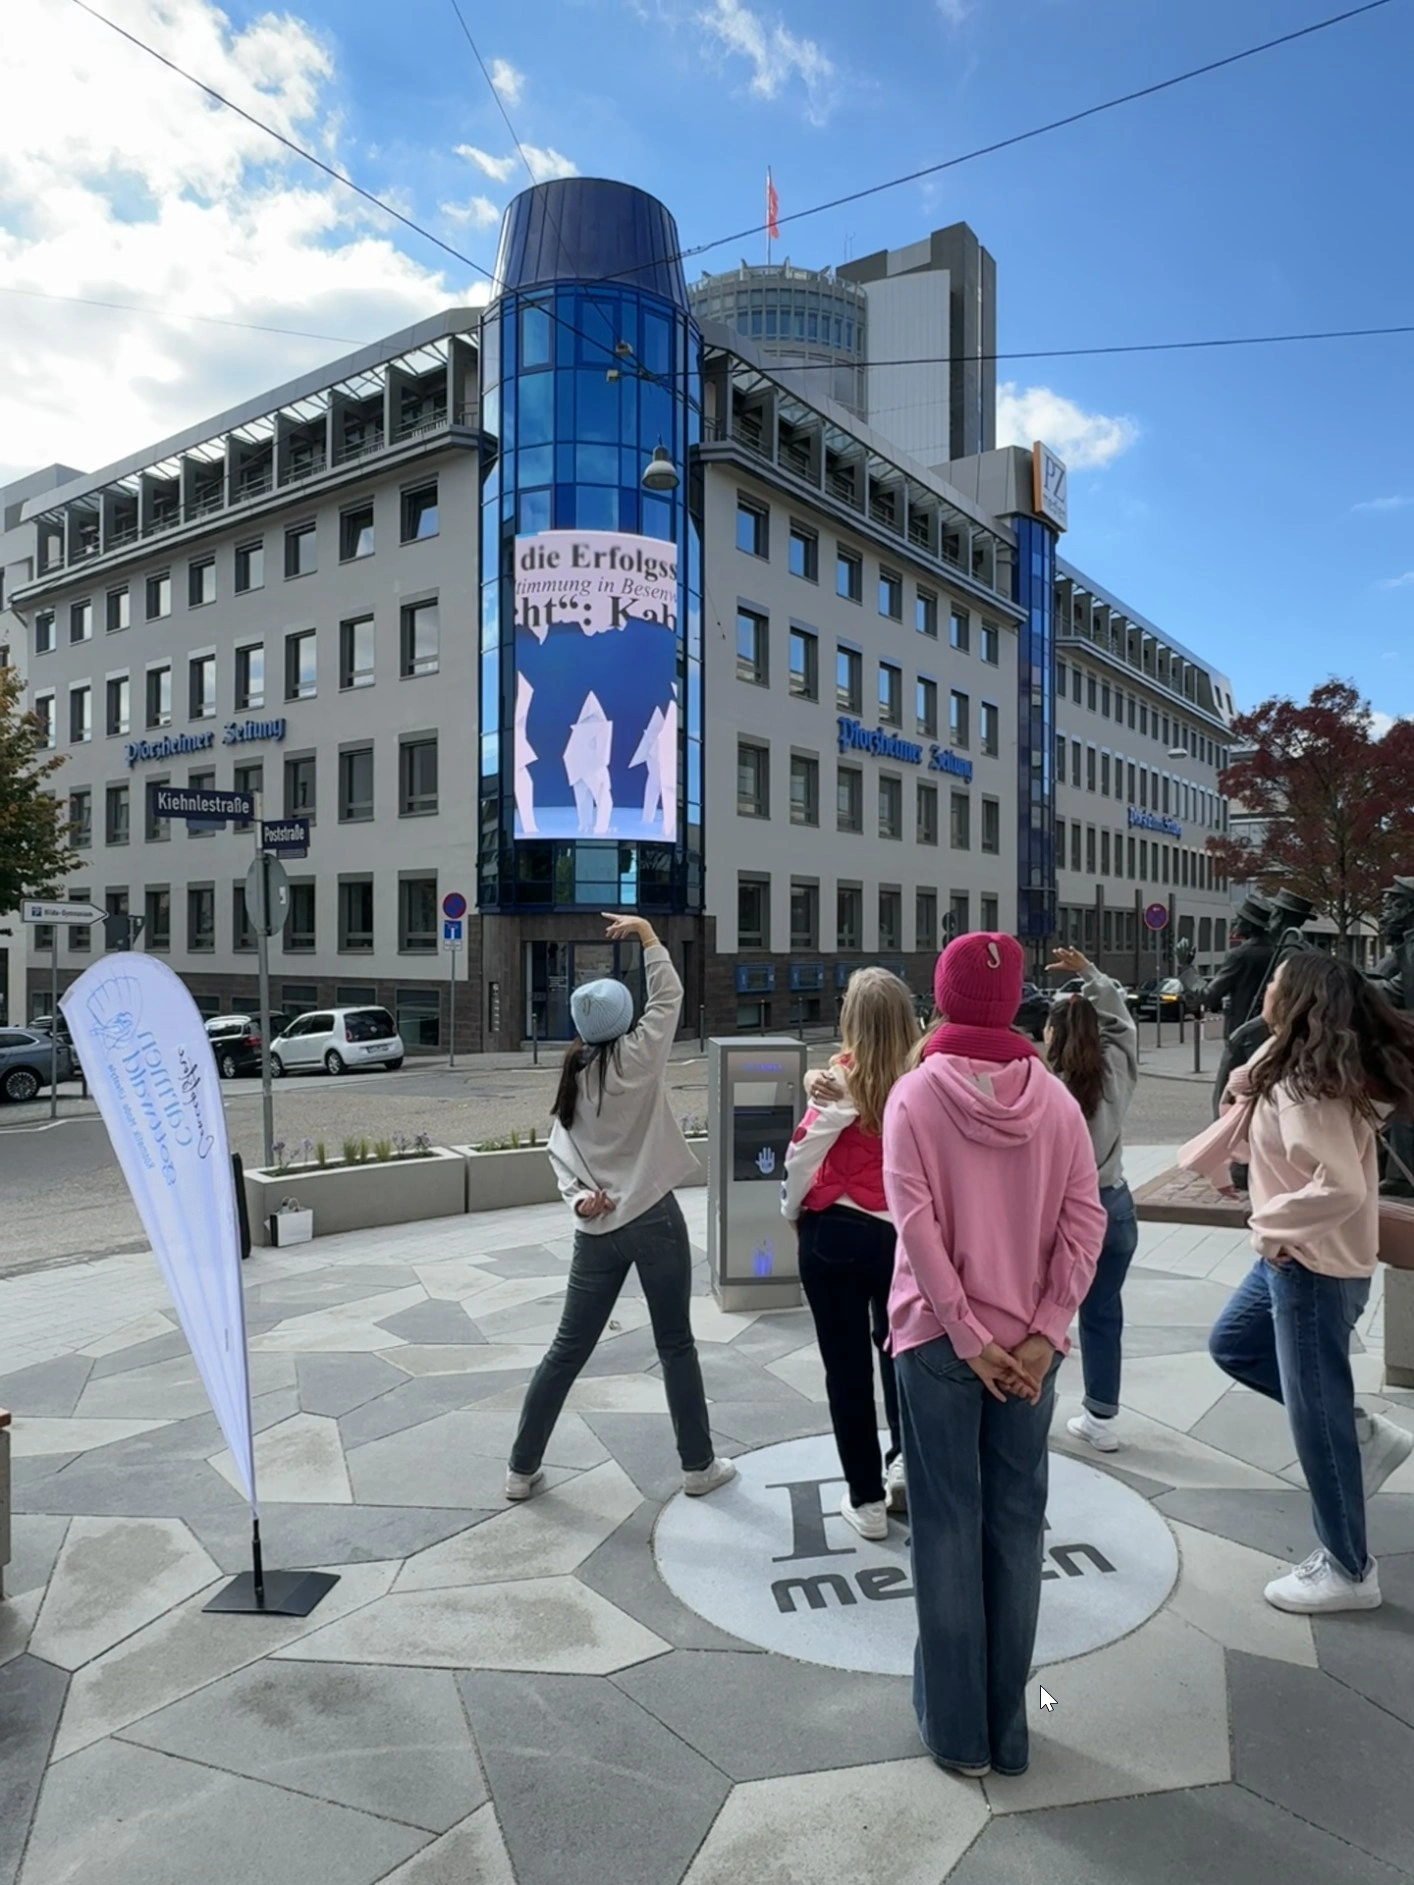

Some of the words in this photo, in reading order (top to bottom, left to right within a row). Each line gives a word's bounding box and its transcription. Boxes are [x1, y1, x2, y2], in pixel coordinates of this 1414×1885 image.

[521, 545, 560, 571] die
[571, 544, 677, 583] Erfolgss
[598, 577, 615, 593] in
[158, 792, 249, 814] Kiehnlestraße
[264, 823, 305, 843] Poststraße
